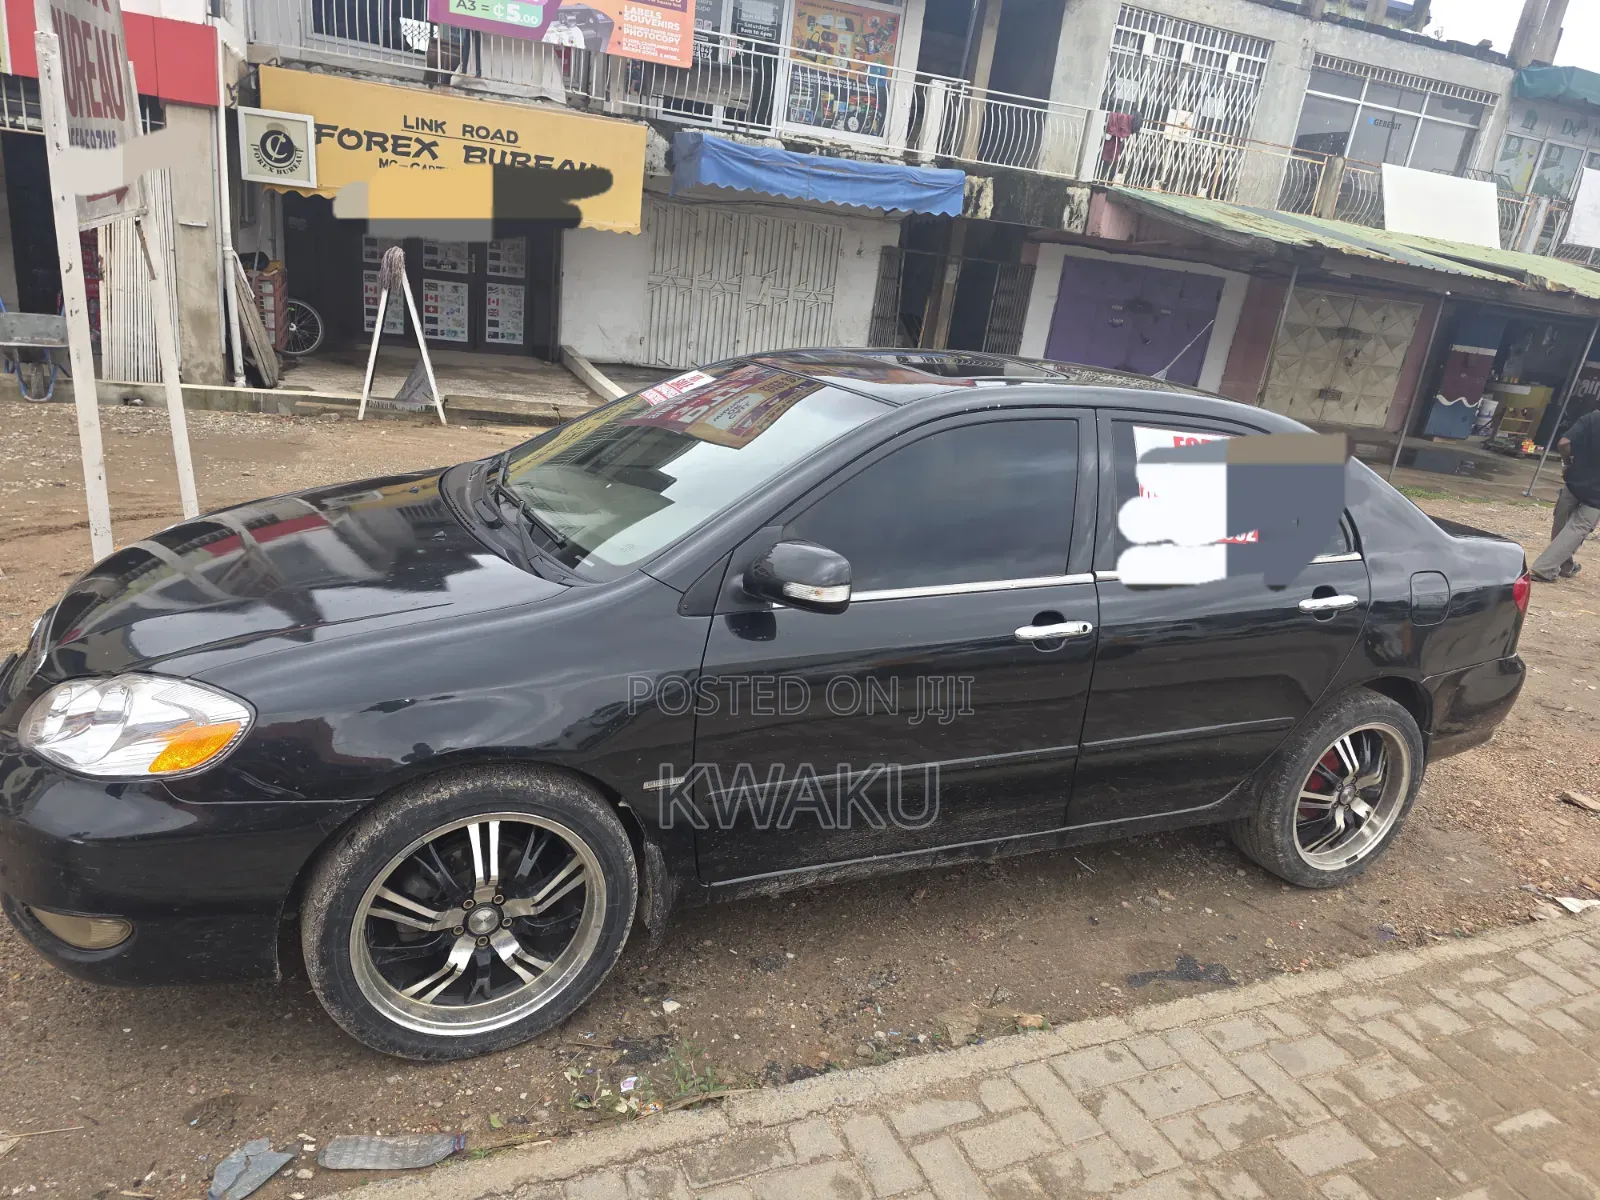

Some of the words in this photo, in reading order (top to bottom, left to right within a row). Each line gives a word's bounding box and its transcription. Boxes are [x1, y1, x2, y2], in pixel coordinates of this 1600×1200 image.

[624, 5, 662, 19] LABELS
[623, 13, 680, 31] SOUVENIRS
[623, 27, 681, 45] PHOTOCOPY
[403, 115, 447, 134] LINK
[461, 123, 519, 144] ROAD
[314, 122, 439, 161] FOREX
